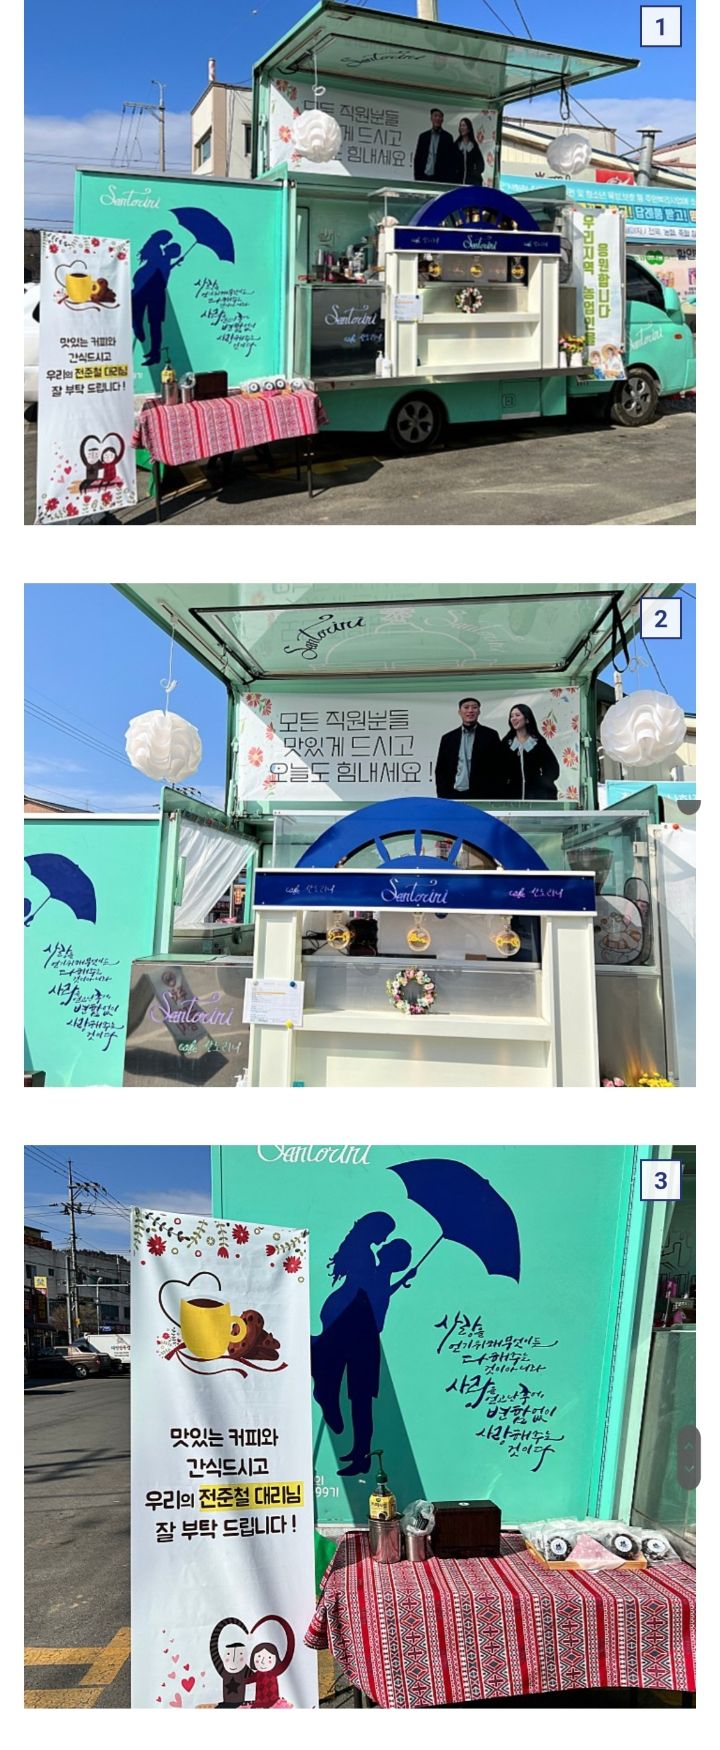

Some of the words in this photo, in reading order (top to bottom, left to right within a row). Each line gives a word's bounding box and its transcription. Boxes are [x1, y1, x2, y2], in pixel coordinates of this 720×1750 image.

[339, 103, 399, 127] 직원분들
[358, 127, 402, 147] 드시고
[347, 146, 406, 167] 힘내세요
[100, 184, 160, 209] Santorini
[635, 206, 663, 220] 답례품
[665, 208, 688, 222] 받고!
[583, 214, 595, 275] 우리지역
[598, 243, 611, 319] 응원합니다
[324, 304, 377, 325] Santorini
[59, 337, 88, 349] 맛있는
[91, 336, 117, 348] 커피와
[68, 351, 112, 364] 간식드시고
[46, 368, 73, 382] 우리의
[74, 366, 102, 380] 전준철
[104, 365, 128, 379] 대리님
[51, 385, 63, 398] 잘
[65, 383, 85, 396] 부탁
[87, 381, 120, 394] 드립니다
[283, 613, 366, 661] Santorini
[279, 710, 320, 733] 모든
[325, 709, 410, 732] 직원분들
[284, 736, 345, 757] 맛있게
[351, 735, 414, 757] 드시고
[269, 762, 330, 783] 오늘도
[337, 761, 422, 783] 힘내세요
[381, 878, 449, 905] Santorini
[150, 991, 234, 1026] Santorini
[170, 1427, 224, 1448] 맛있는
[228, 1428, 279, 1447] 커피와
[186, 1457, 269, 1478] 간식드시고
[145, 1490, 194, 1511] 우리의
[199, 1486, 250, 1509] 전준철
[254, 1484, 301, 1505] 대리님
[155, 1520, 176, 1543] 잘
[181, 1518, 218, 1541] 부탁
[223, 1515, 287, 1537] 드립니다
